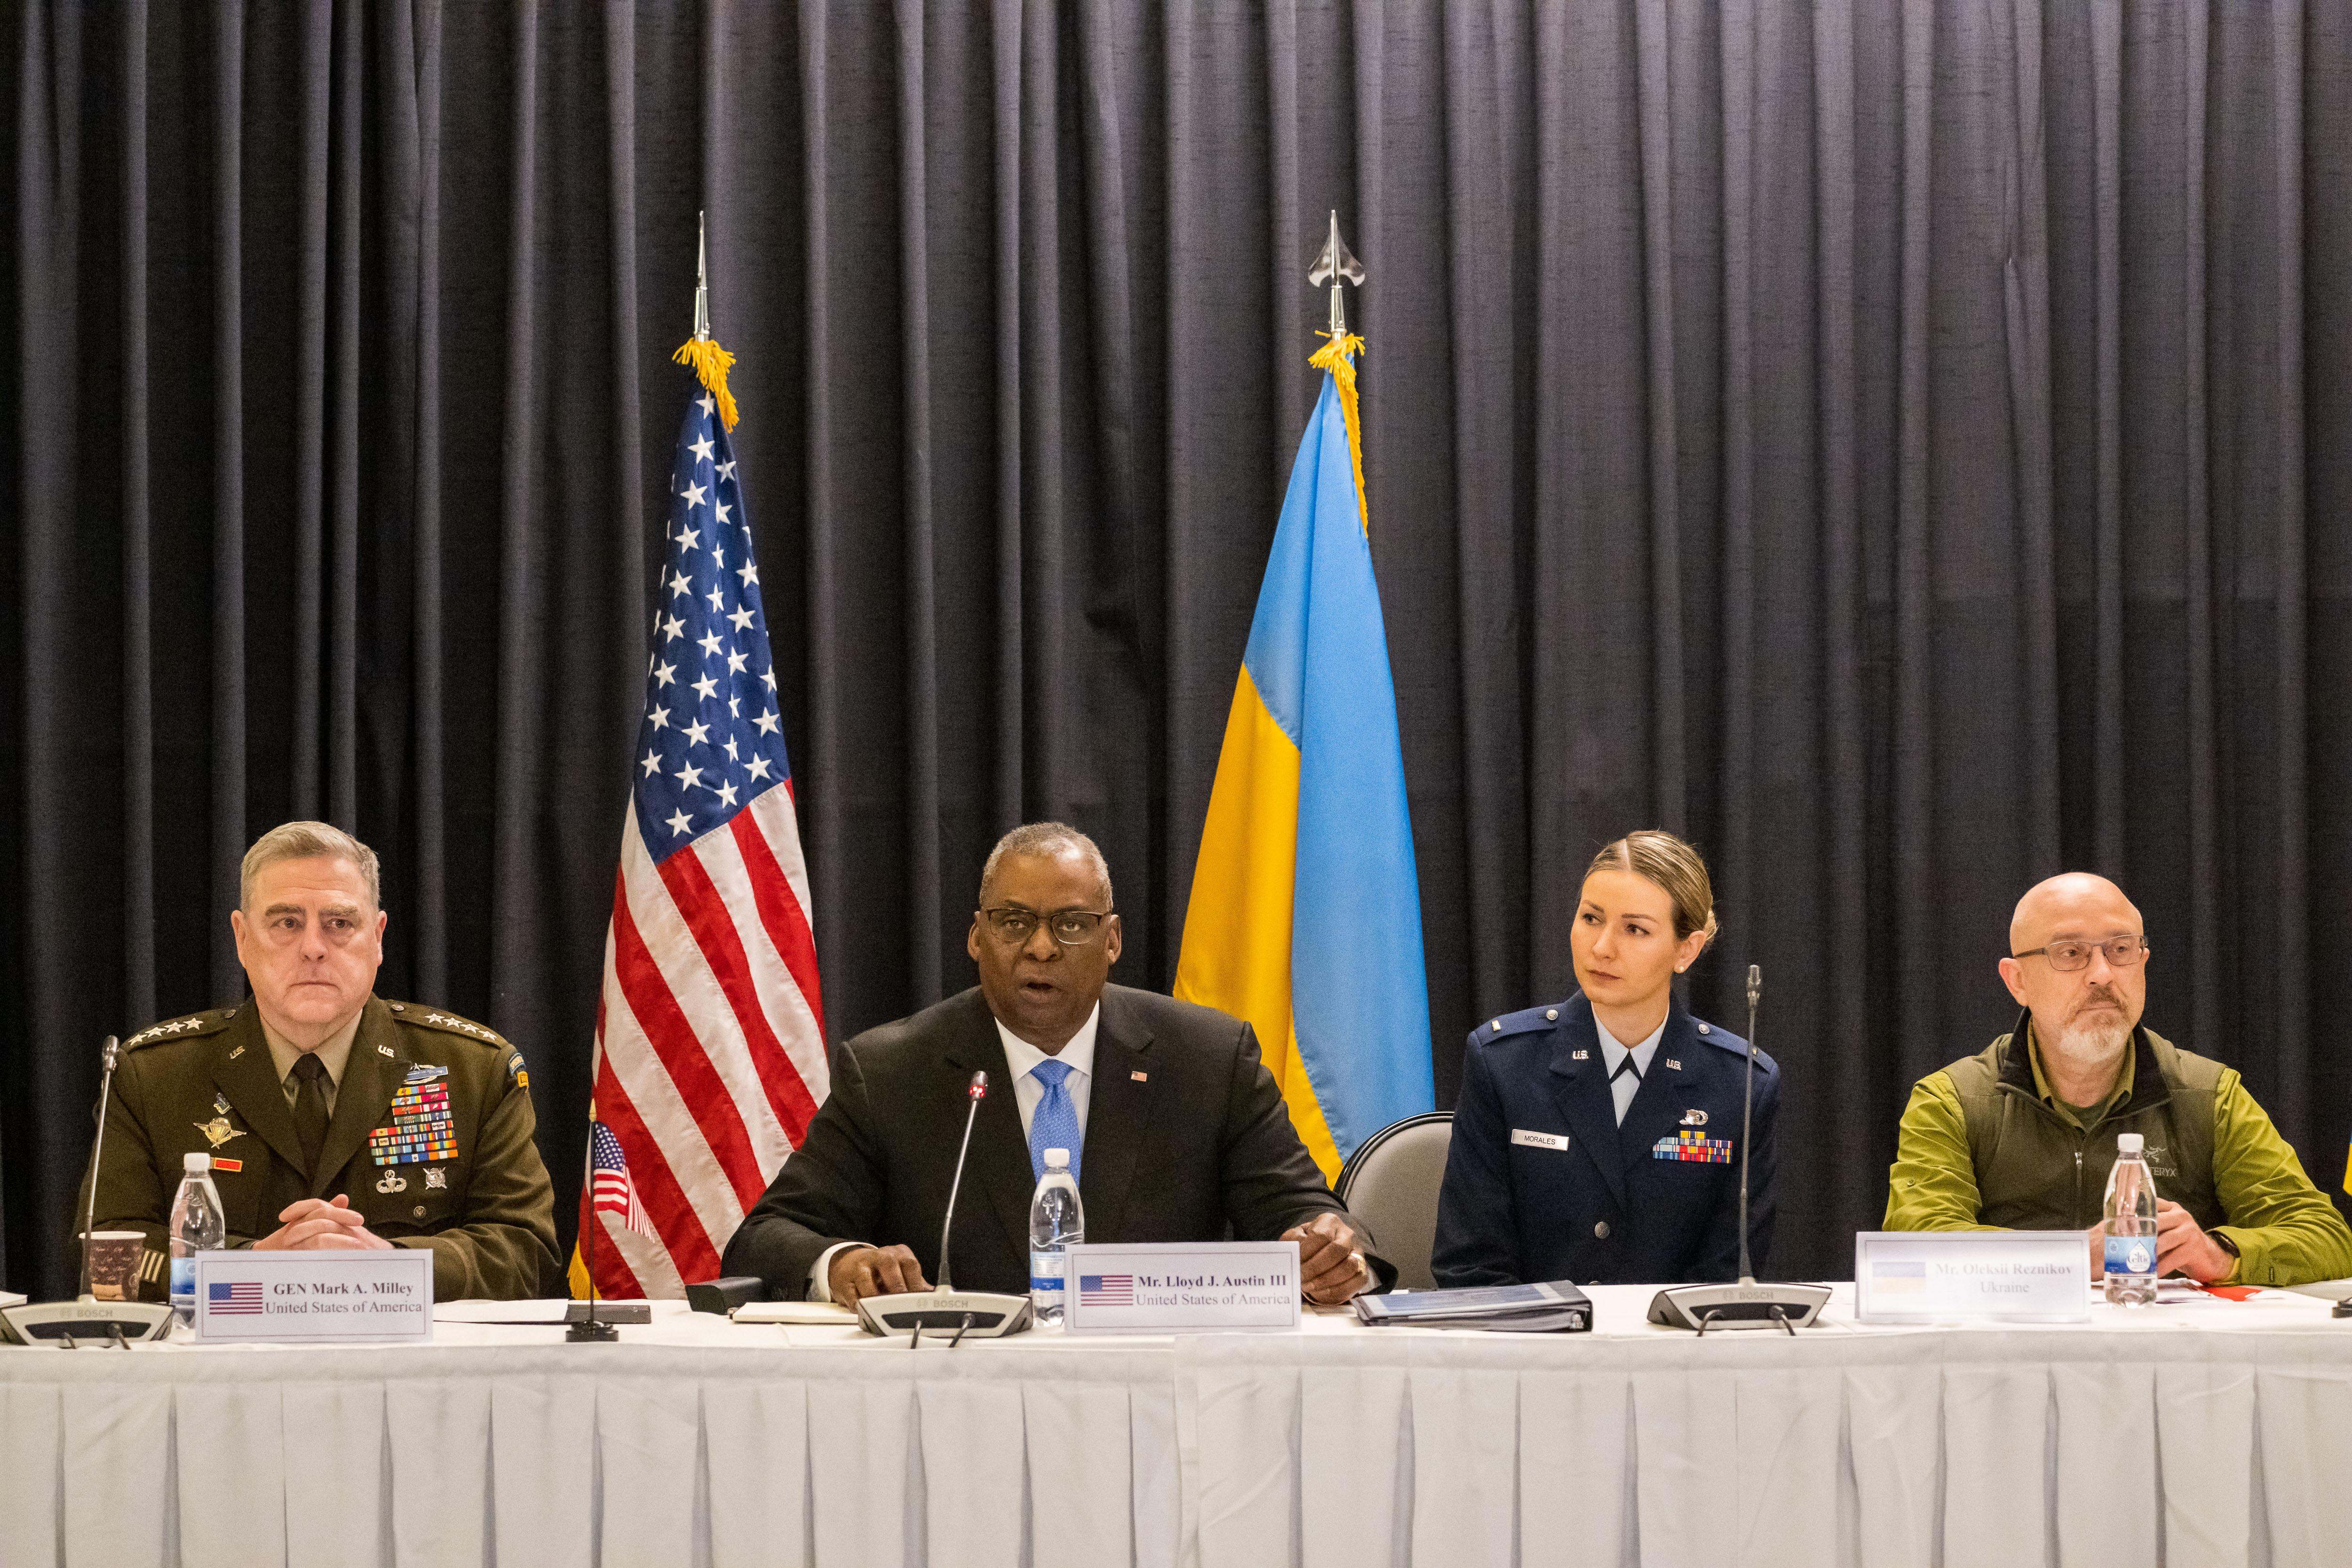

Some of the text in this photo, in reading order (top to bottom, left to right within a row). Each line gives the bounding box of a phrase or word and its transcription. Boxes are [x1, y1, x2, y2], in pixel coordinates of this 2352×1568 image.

[1524, 1135, 1556, 1145] MORALES
[1935, 1263, 2072, 1275] Mr. Oleksii Reznikov
[1138, 1275, 1287, 1289] Mr. Lloyd J. Austin III
[1980, 1281, 2030, 1293] Ukraine
[273, 1282, 413, 1297] GEN Mark A. Milley
[933, 1299, 969, 1308] BOSCH
[1136, 1293, 1290, 1305] United States of America
[265, 1301, 422, 1313] United States of America
